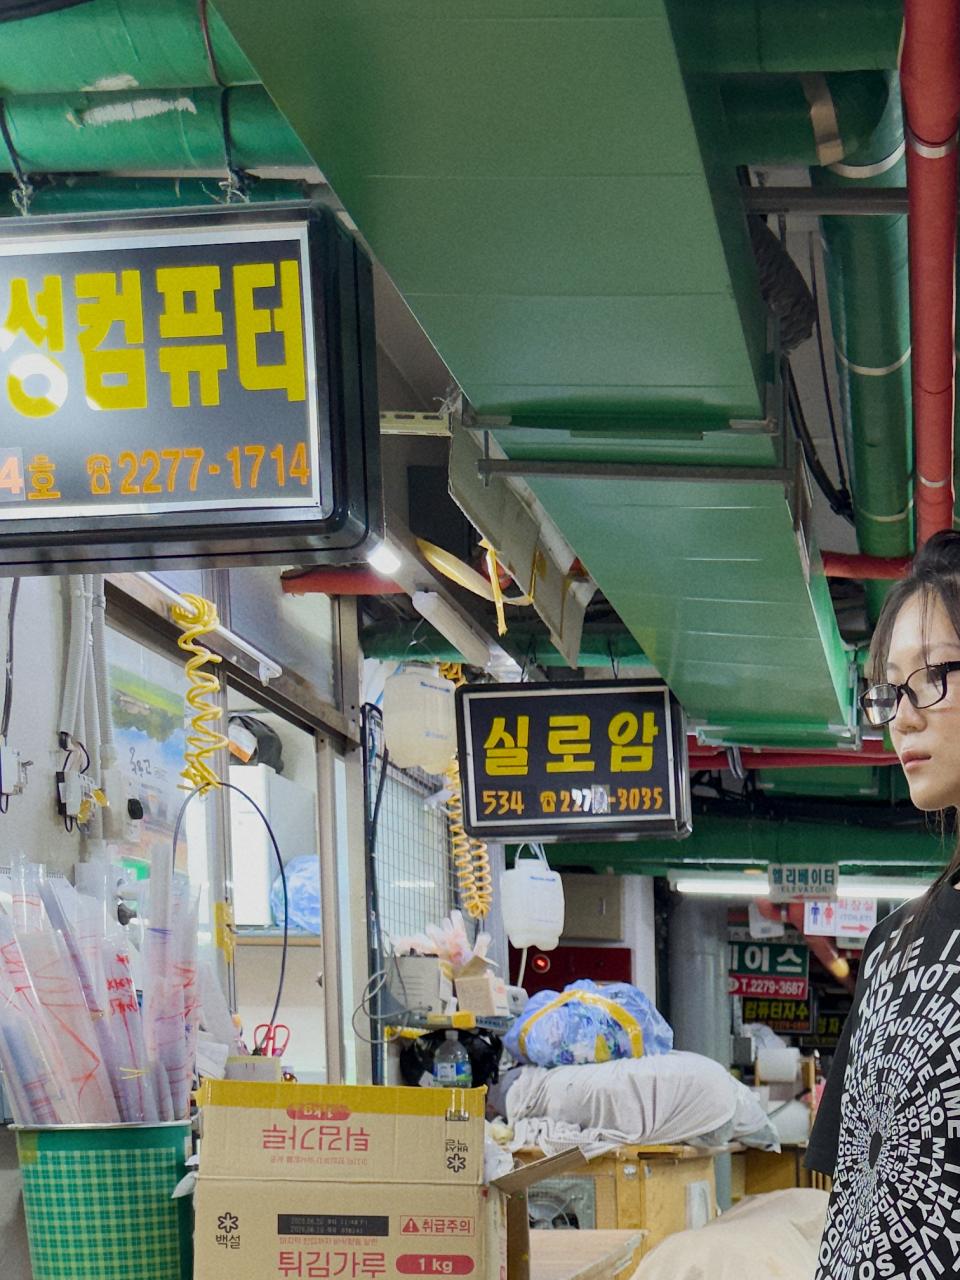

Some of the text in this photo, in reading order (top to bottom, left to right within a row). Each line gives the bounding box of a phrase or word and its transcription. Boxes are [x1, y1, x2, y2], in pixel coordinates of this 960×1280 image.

[118, 442, 310, 495] 2277-1714
[483, 711, 659, 777] 실로암
[482, 790, 525, 815] 534
[871, 1016, 945, 1056] ENOUGH
[926, 1087, 945, 1127] SO
[916, 1137, 947, 1221] MANY
[215, 1234, 241, 1249] 백설
[421, 1219, 471, 1233] 취급주의
[899, 1182, 960, 1264] HAVE
[278, 1251, 386, 1278] 튀김가루
[431, 1258, 453, 1273] kg
